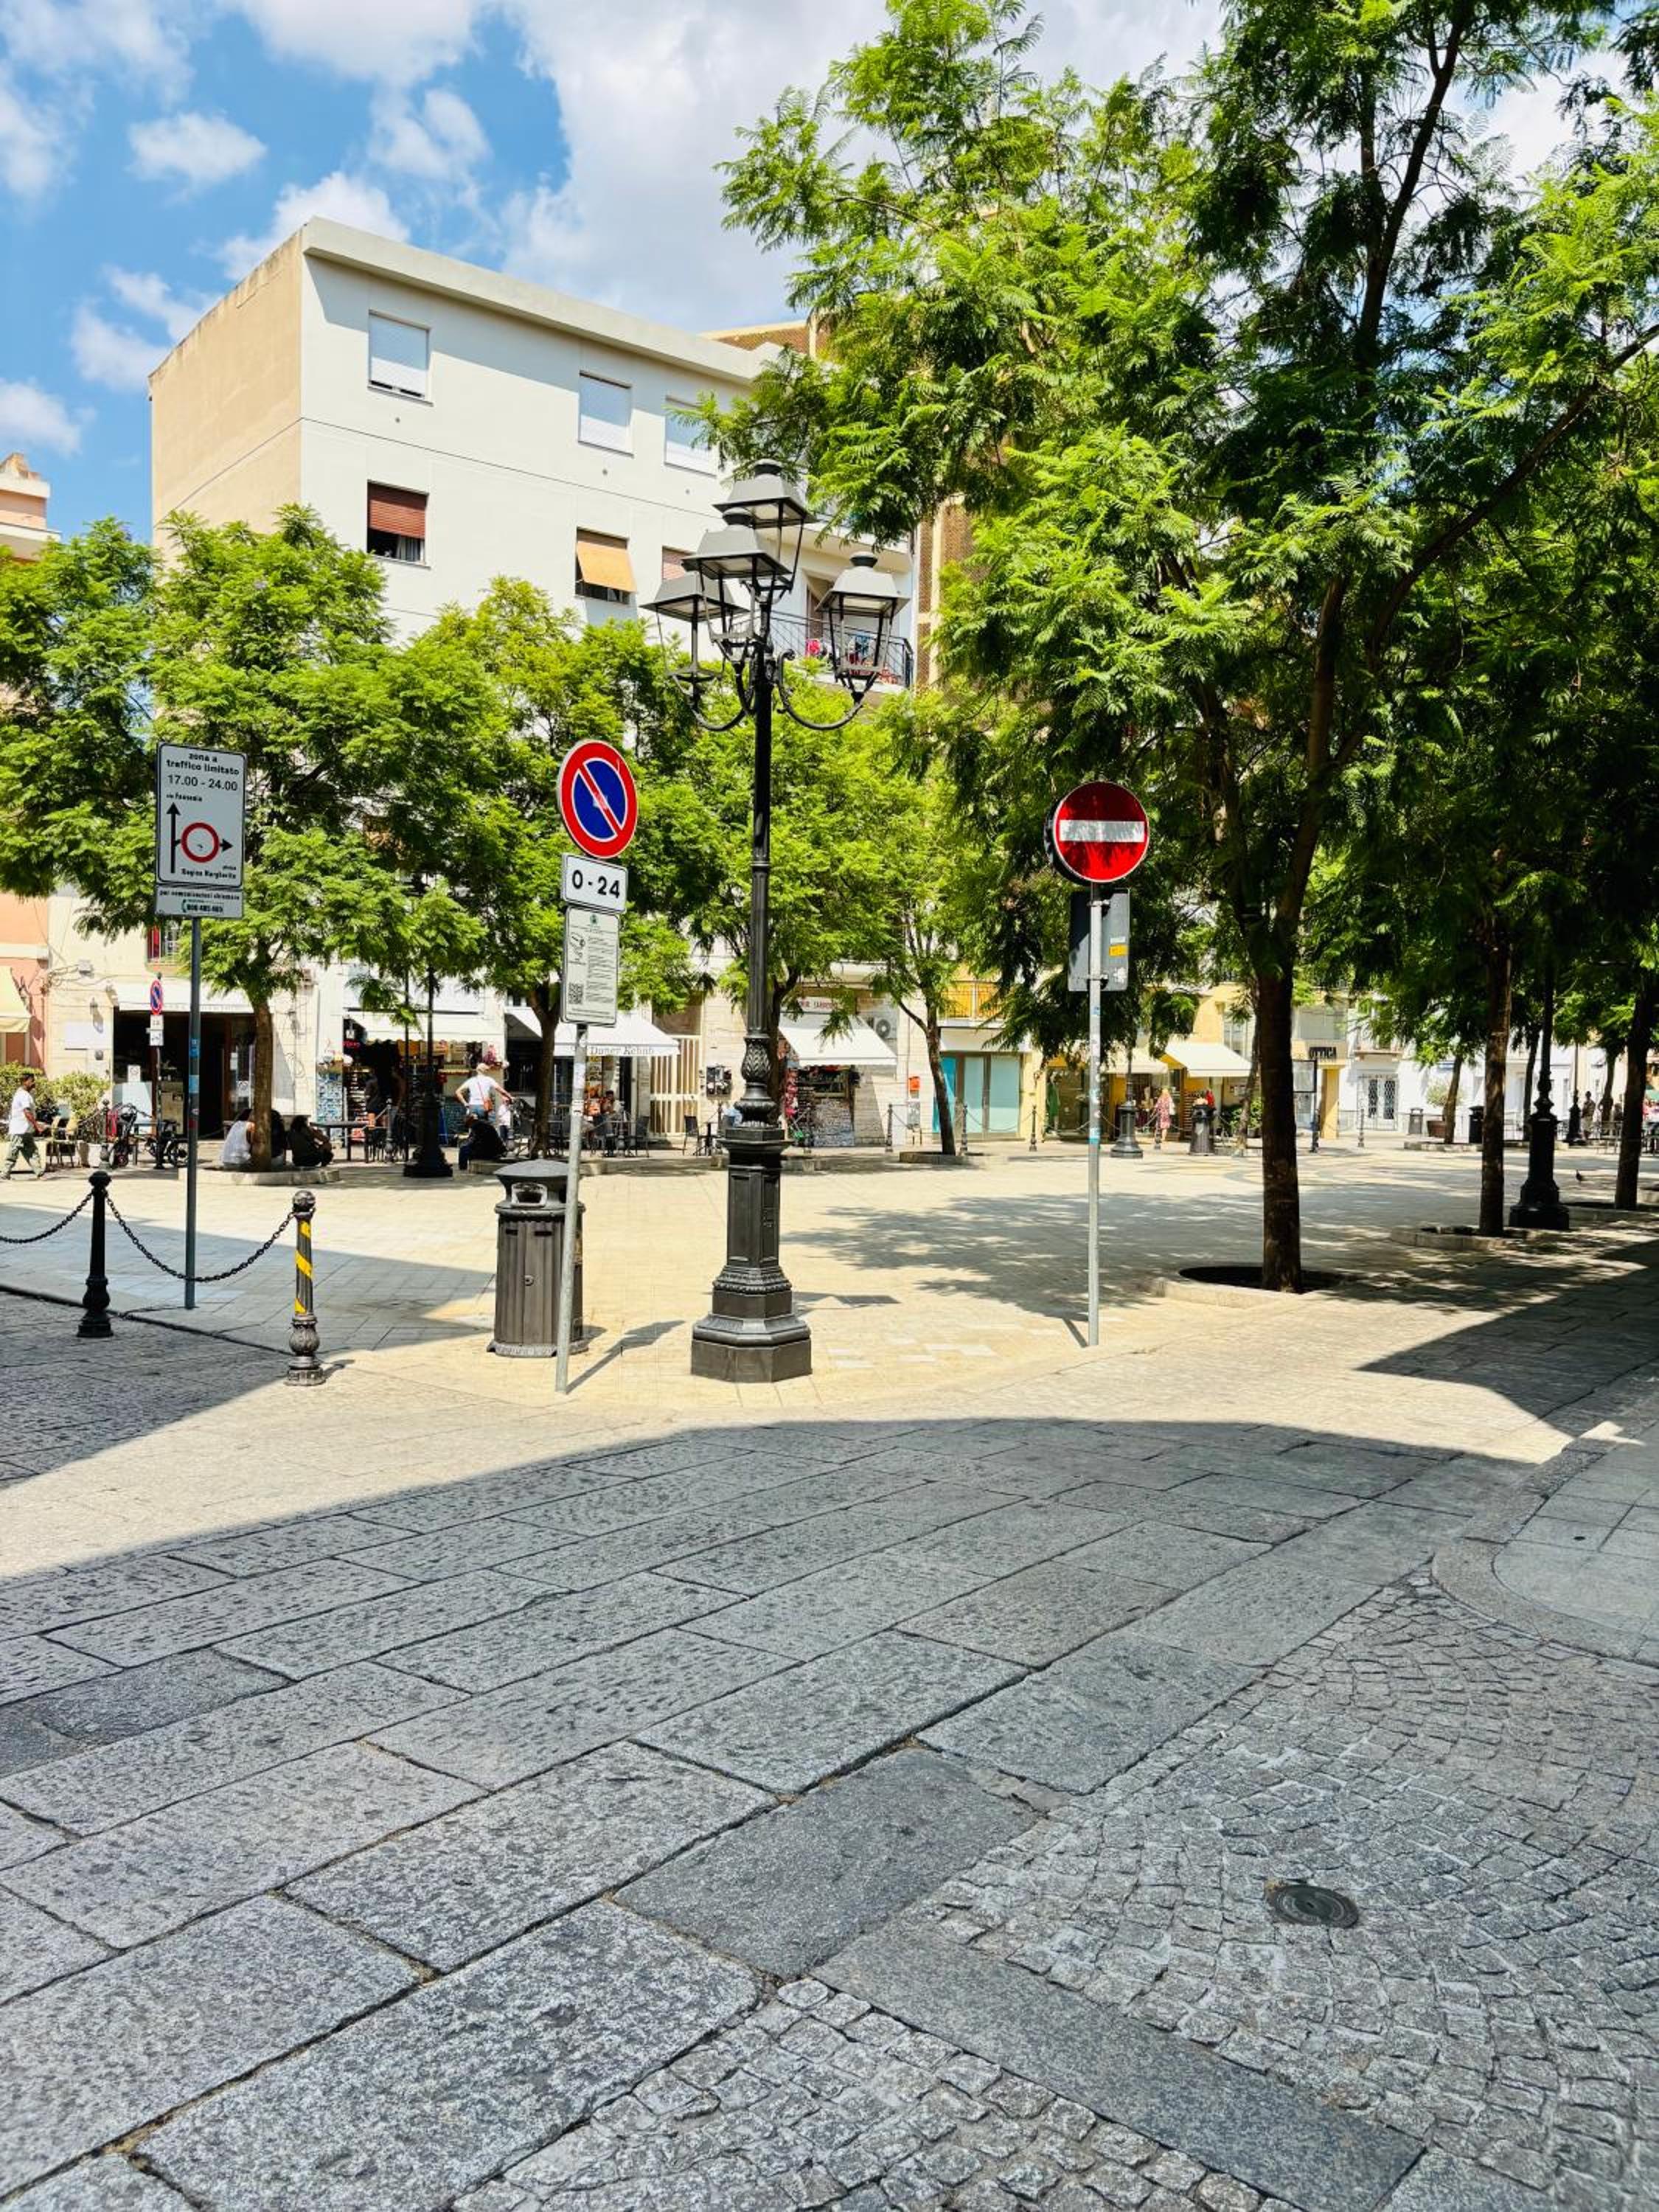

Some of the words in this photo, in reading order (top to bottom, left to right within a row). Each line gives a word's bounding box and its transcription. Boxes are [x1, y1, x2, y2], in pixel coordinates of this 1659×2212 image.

[188, 753, 210, 762] zona
[166, 759, 201, 771] traffico
[204, 764, 240, 775] limitato
[167, 774, 198, 786] 17.00
[208, 778, 238, 791] 24.00
[572, 869, 583, 889] 0
[597, 875, 620, 899] 24
[1309, 1046, 1337, 1060] OTTICA
